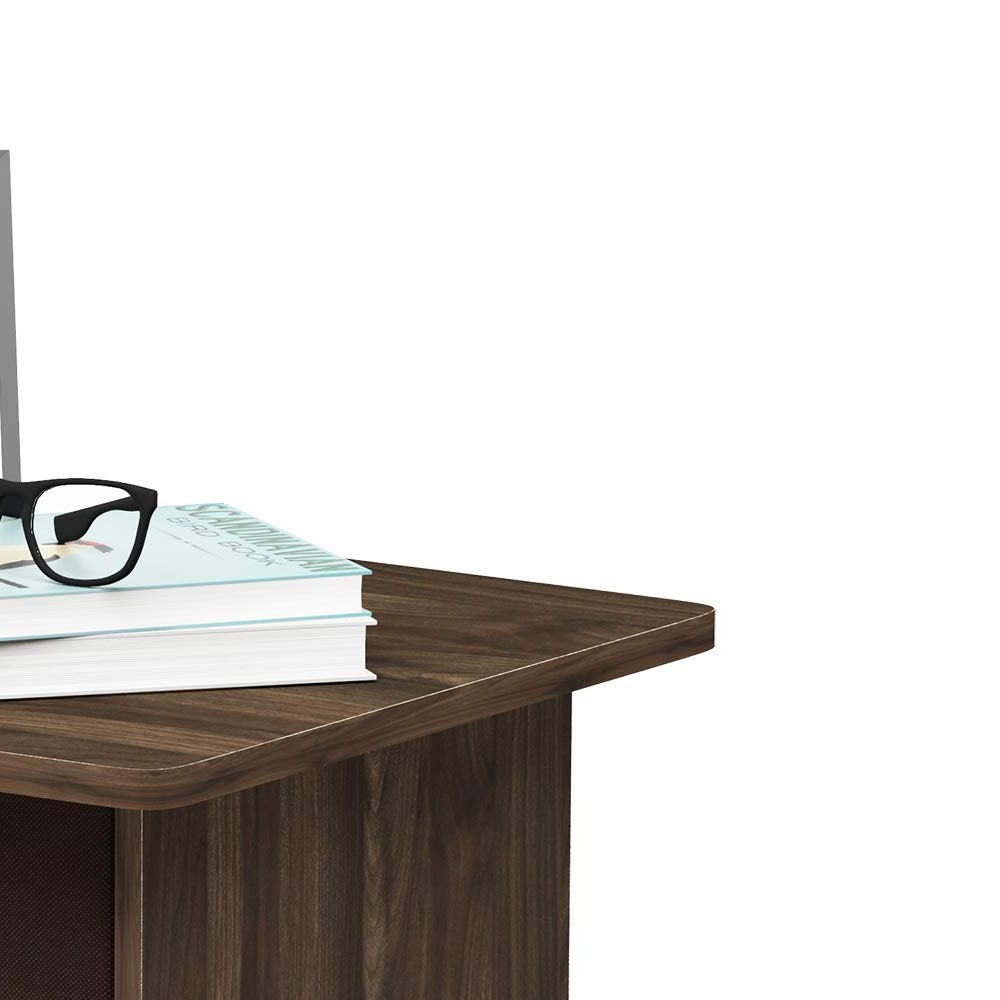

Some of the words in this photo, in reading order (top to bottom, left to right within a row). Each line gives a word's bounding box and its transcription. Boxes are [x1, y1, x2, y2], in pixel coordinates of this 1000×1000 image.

[167, 517, 220, 538] BIRD
[218, 541, 284, 566] BOOK
[176, 503, 361, 572] SCANDINAVIAN
